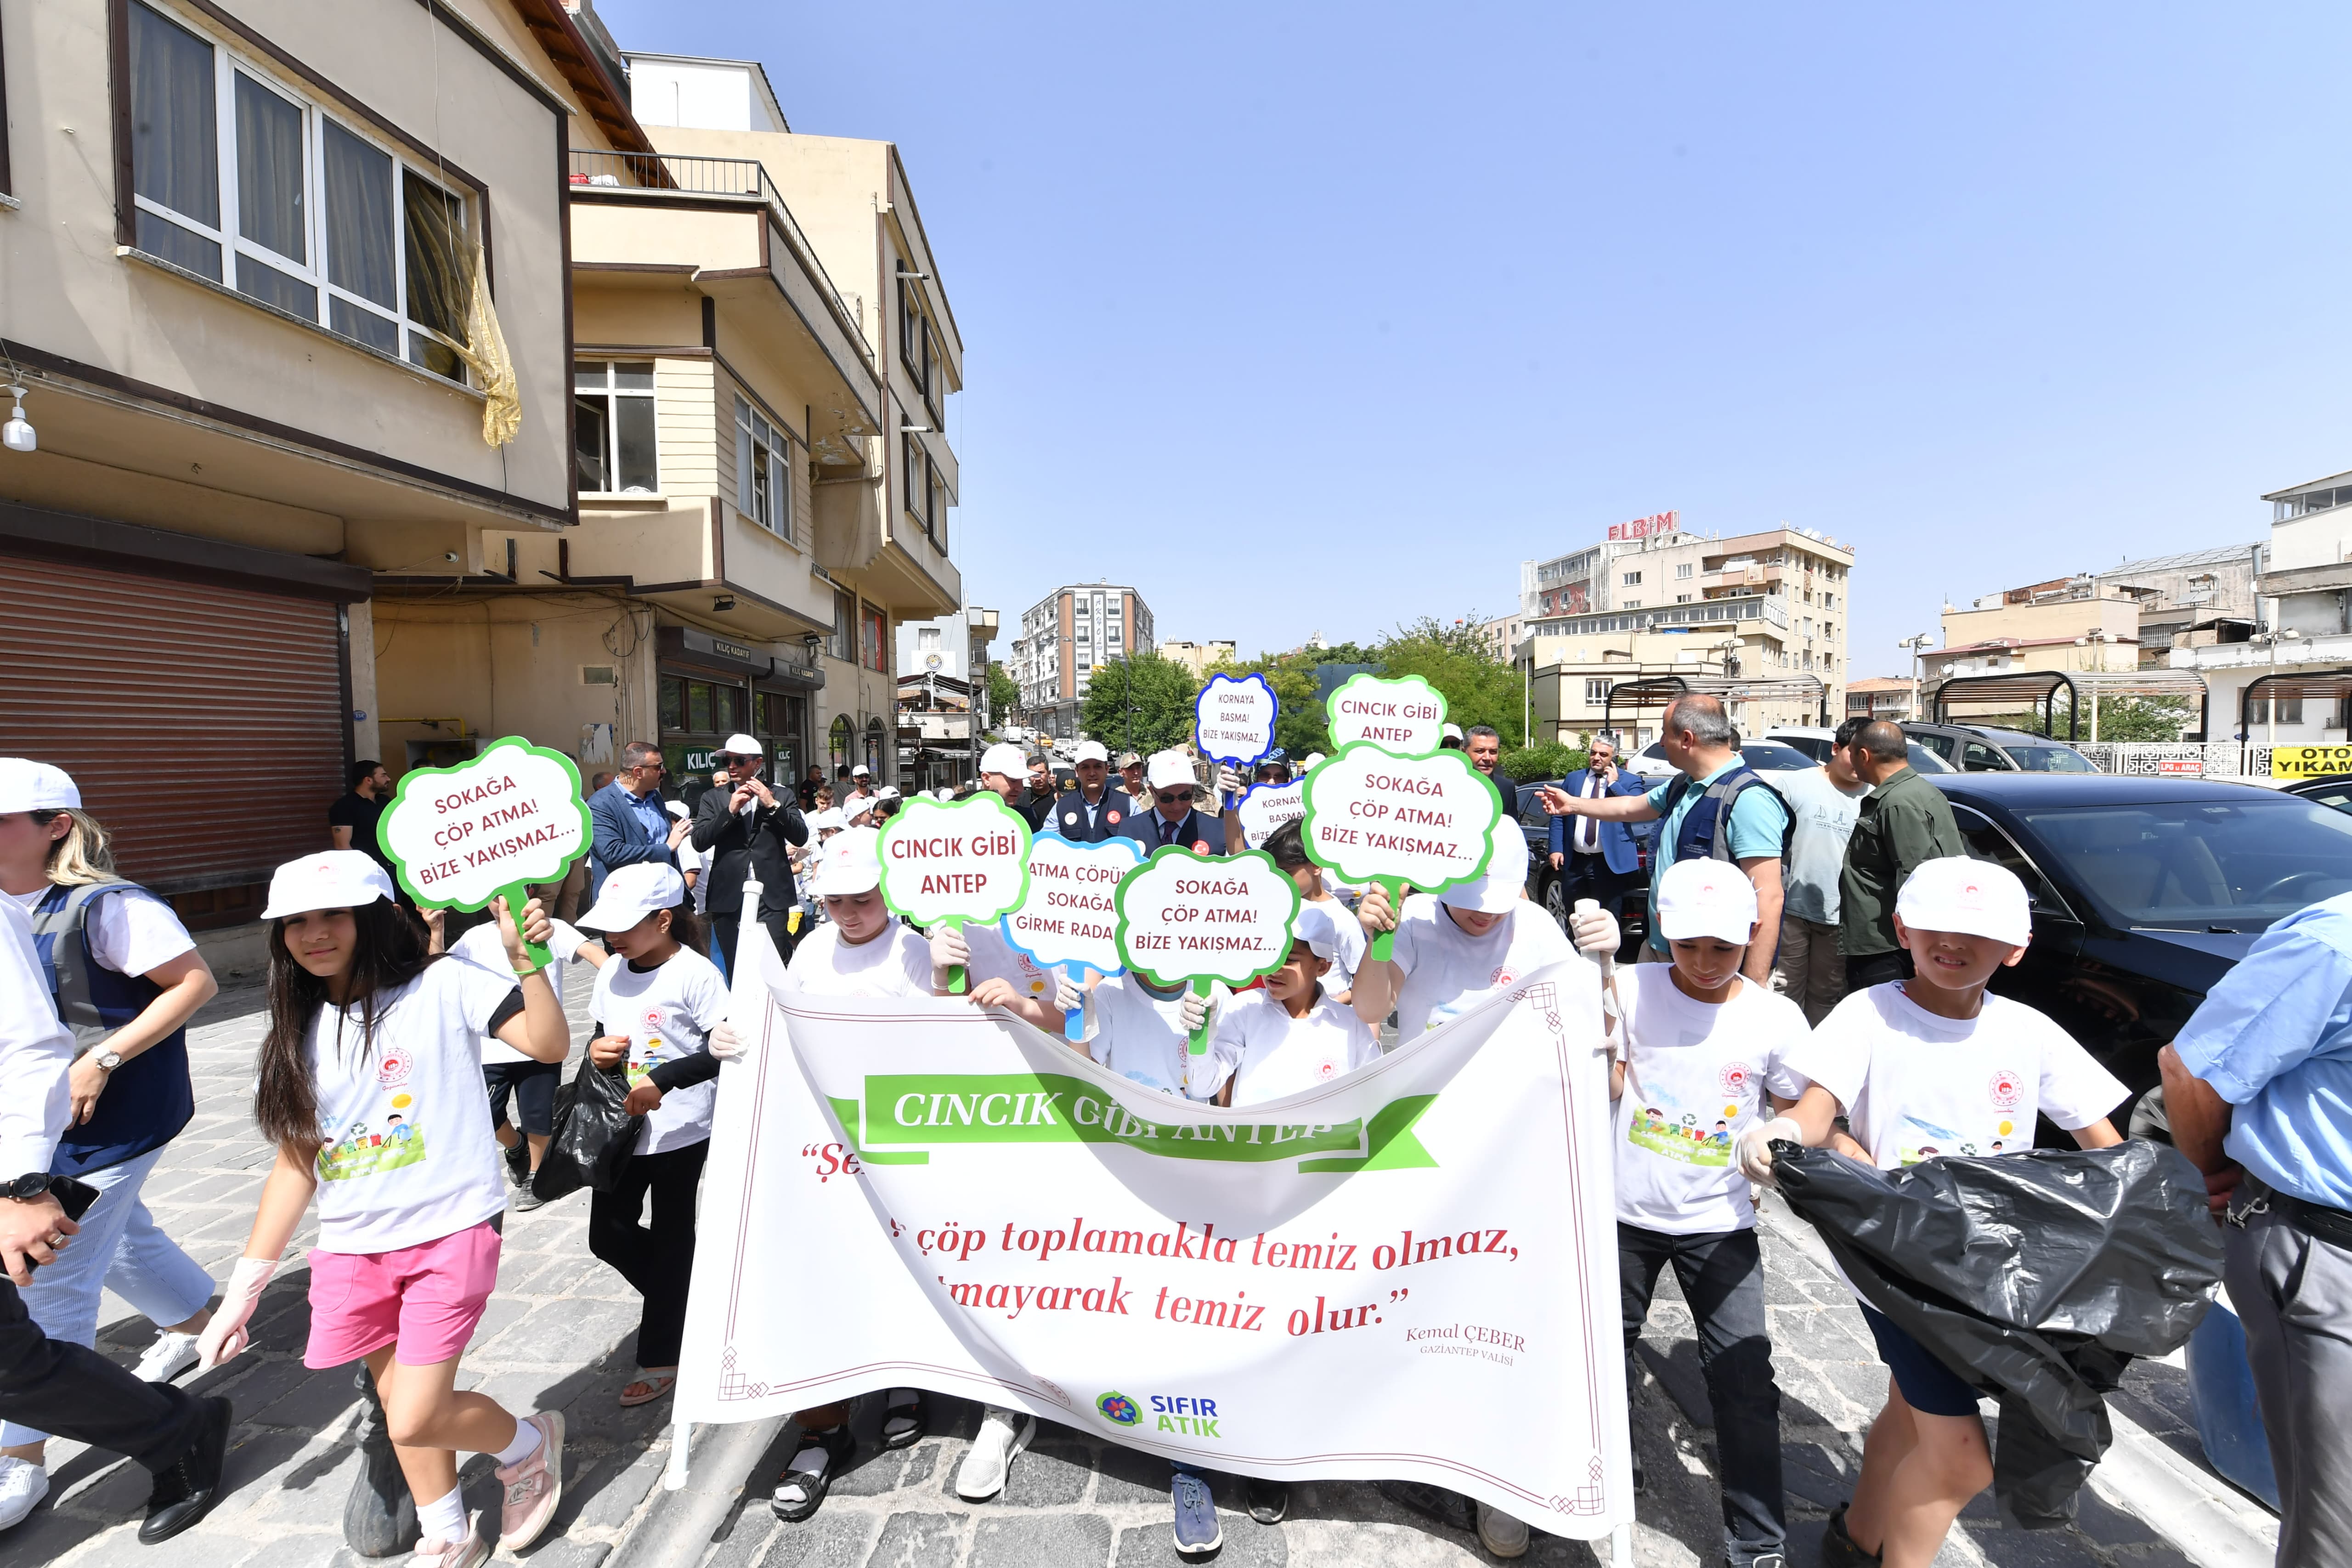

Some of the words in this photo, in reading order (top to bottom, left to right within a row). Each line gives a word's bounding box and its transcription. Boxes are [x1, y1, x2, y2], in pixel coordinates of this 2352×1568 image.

[716, 642, 730, 656] KILIÇ
[731, 646, 750, 658] KADAYIF
[1218, 694, 1255, 705] KORNAYA
[1341, 700, 1397, 717] CINCIK
[1403, 702, 1437, 720] GİBİ
[1220, 713, 1250, 724] BASMA!
[1203, 727, 1218, 739] BİZE
[1221, 730, 1266, 744] YAKIŞMAZ...
[1361, 726, 1413, 742] ANTEP
[687, 752, 716, 770] KILIÇ
[2301, 748, 2351, 759] OTO
[2181, 764, 2200, 772] ARAÇ
[434, 776, 517, 814] SOKAĞA
[1365, 774, 1443, 797] SOKAĞA
[1262, 795, 1303, 809] KORNAY
[1350, 798, 1389, 819] ÇÖP
[1395, 808, 1453, 828] ATMA!
[434, 821, 474, 850] ÇÖP
[482, 798, 539, 831] ATMA!
[891, 838, 963, 859] CINCIK
[971, 830, 1016, 856] GİBİ
[1251, 830, 1270, 841] BİZE
[1321, 824, 1358, 845] BİZE
[1366, 832, 1473, 860] YAKIŞMAZ...
[419, 859, 461, 885] BİZE
[464, 823, 575, 858] YAKIŞMAZ...
[1029, 862, 1069, 879] ATMA
[921, 874, 987, 894] ANTEP
[1176, 877, 1249, 895] SOKAĞA
[1161, 904, 1199, 925] ÇÖP
[1204, 909, 1257, 923] ATMA!
[1016, 913, 1065, 934] GİRME
[1071, 922, 1114, 940] RADA
[1135, 932, 1171, 949] BİZE
[1178, 936, 1277, 954] YAKIŞMAZ...
[894, 1092, 1063, 1127] CINCIK
[802, 1143, 865, 1183] “Şe
[917, 1221, 986, 1261] çöp
[1001, 1217, 1238, 1263] toplamakla
[1251, 1232, 1357, 1271] temiz
[1372, 1228, 1519, 1270] olmaz,
[1154, 1286, 1266, 1332] temiz
[1287, 1288, 1409, 1337] olur.”
[1405, 1323, 1459, 1342] Kemal
[1464, 1325, 1526, 1353] ÇEBER
[1420, 1343, 1479, 1357] GAZİANTEP
[1481, 1350, 1514, 1367] VALİSİ
[1150, 1395, 1219, 1417] SIFIR
[1157, 1415, 1222, 1438] ATIK
